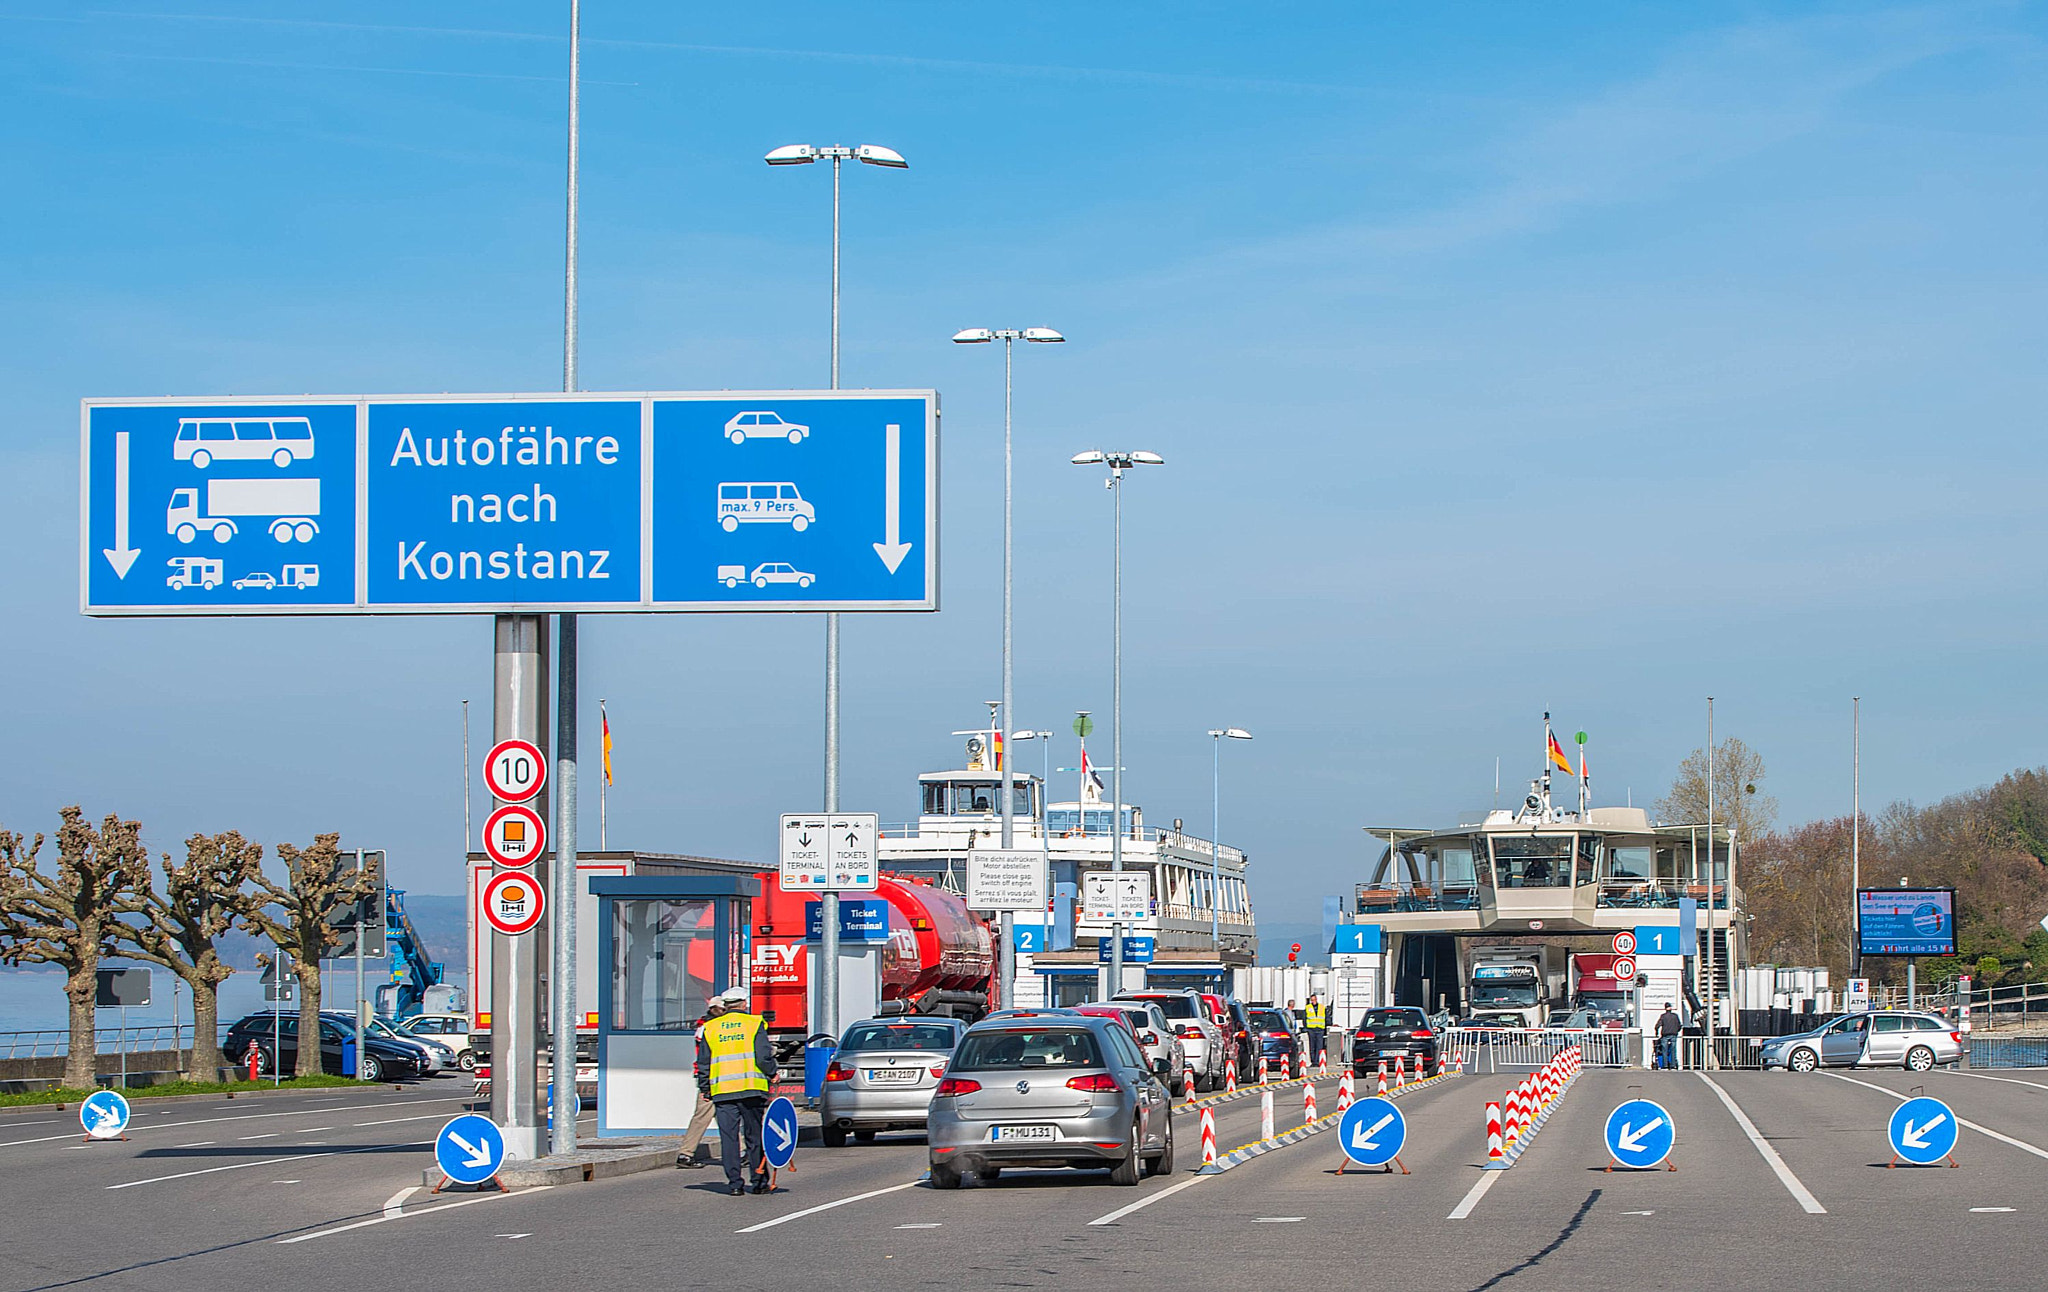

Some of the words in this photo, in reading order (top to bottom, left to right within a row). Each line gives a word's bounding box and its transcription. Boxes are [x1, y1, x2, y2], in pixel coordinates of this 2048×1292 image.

[390, 426, 619, 466] Autofähre
[451, 483, 557, 523] nach
[722, 503, 751, 512] max.
[754, 500, 761, 512] 9
[767, 500, 799, 512] Pers.
[398, 541, 610, 580] Konstanz
[502, 757, 529, 784] 10
[791, 851, 819, 859] TICKET-
[837, 851, 867, 859] TICKETS
[787, 862, 825, 870] TERMINAL
[835, 862, 846, 870] AN
[848, 862, 869, 870] BORD
[850, 910, 877, 918] Ticket
[846, 922, 882, 930] Terminal
[1020, 932, 1033, 948] 2
[1354, 932, 1363, 949] 1
[1653, 933, 1662, 951] 1
[1911, 944, 1925, 952] alle
[1928, 944, 1938, 952] 15
[1620, 963, 1631, 975] 10
[719, 1033, 745, 1043] Service
[1003, 1129, 1009, 1137] F
[1017, 1128, 1030, 1137] MU
[1031, 1127, 1050, 1137] 131
